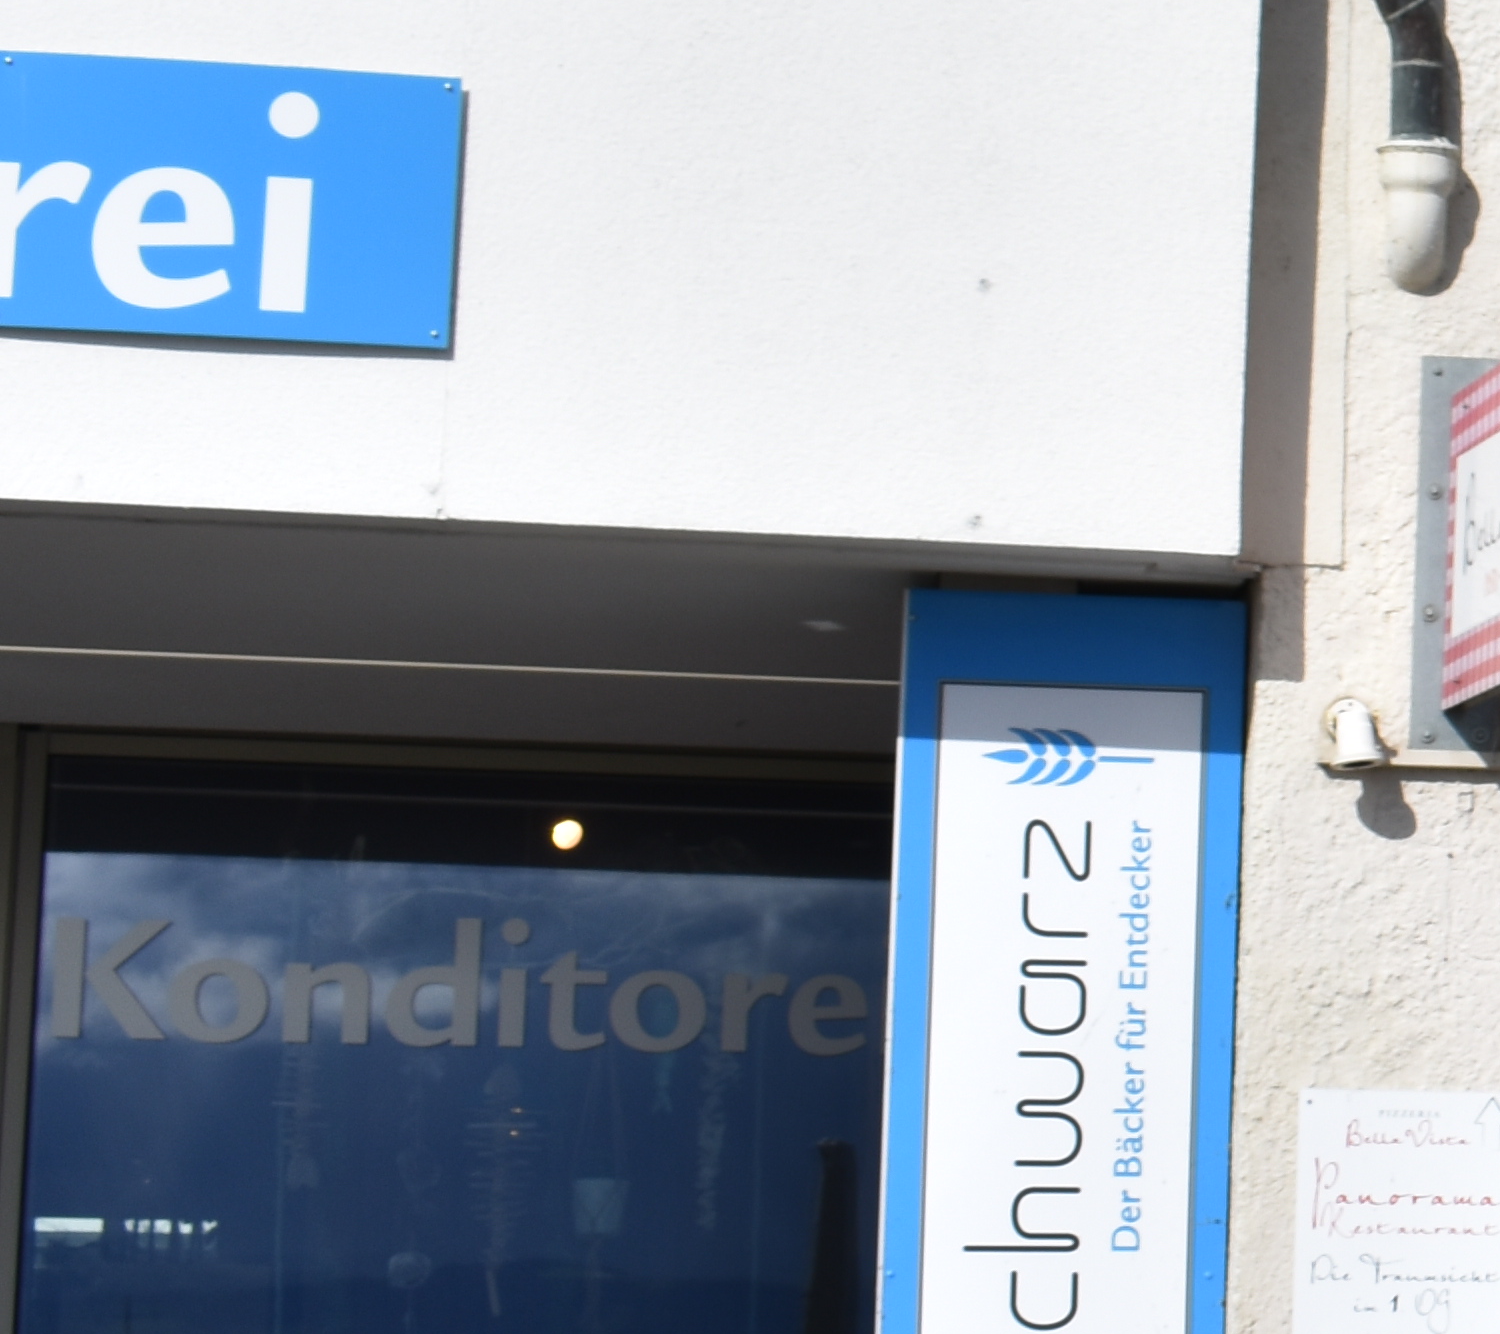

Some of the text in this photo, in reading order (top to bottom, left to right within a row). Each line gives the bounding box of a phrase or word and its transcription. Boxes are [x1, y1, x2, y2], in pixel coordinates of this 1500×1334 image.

[49, 916, 870, 1056] Konditore
[1111, 820, 1152, 1253] Der Bäcker für Entdecker
[1346, 1119, 1470, 1148] Bella Vista
[1310, 1254, 1352, 1284] Die
